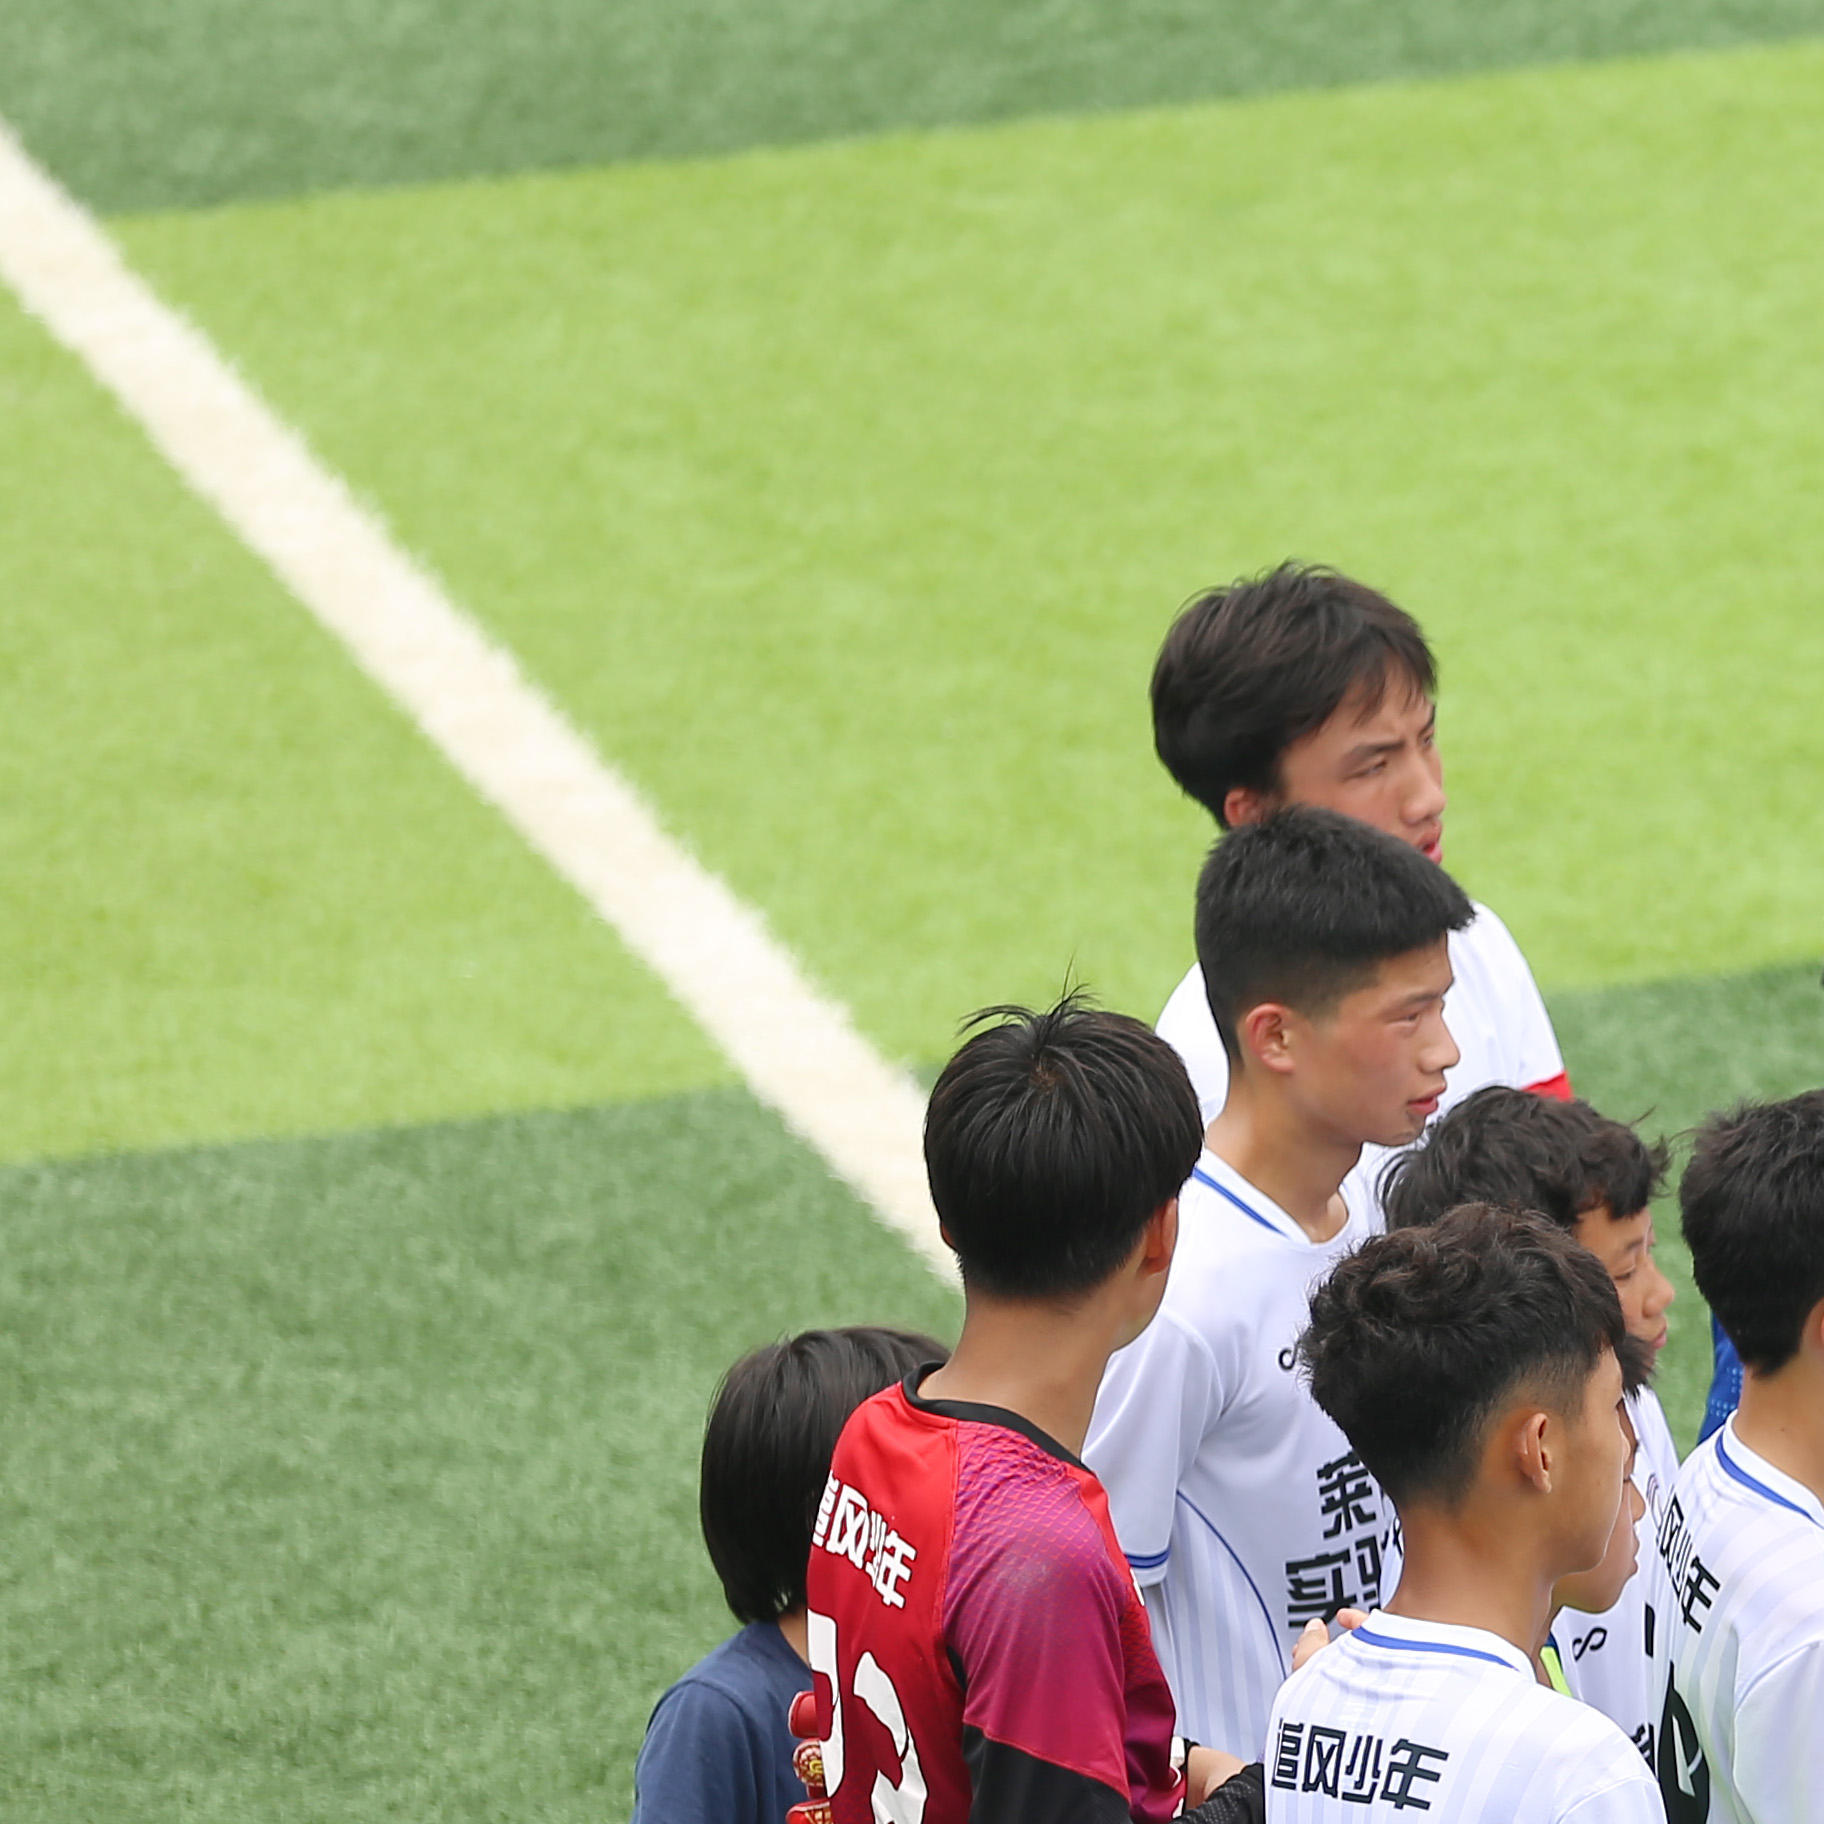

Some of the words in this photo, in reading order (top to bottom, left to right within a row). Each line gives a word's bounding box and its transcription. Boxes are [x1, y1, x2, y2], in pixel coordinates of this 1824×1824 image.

[1317, 1452, 1386, 1541] 莱
[1656, 1484, 1720, 1634] 风少年
[1271, 1718, 1449, 1810] 追风少年
